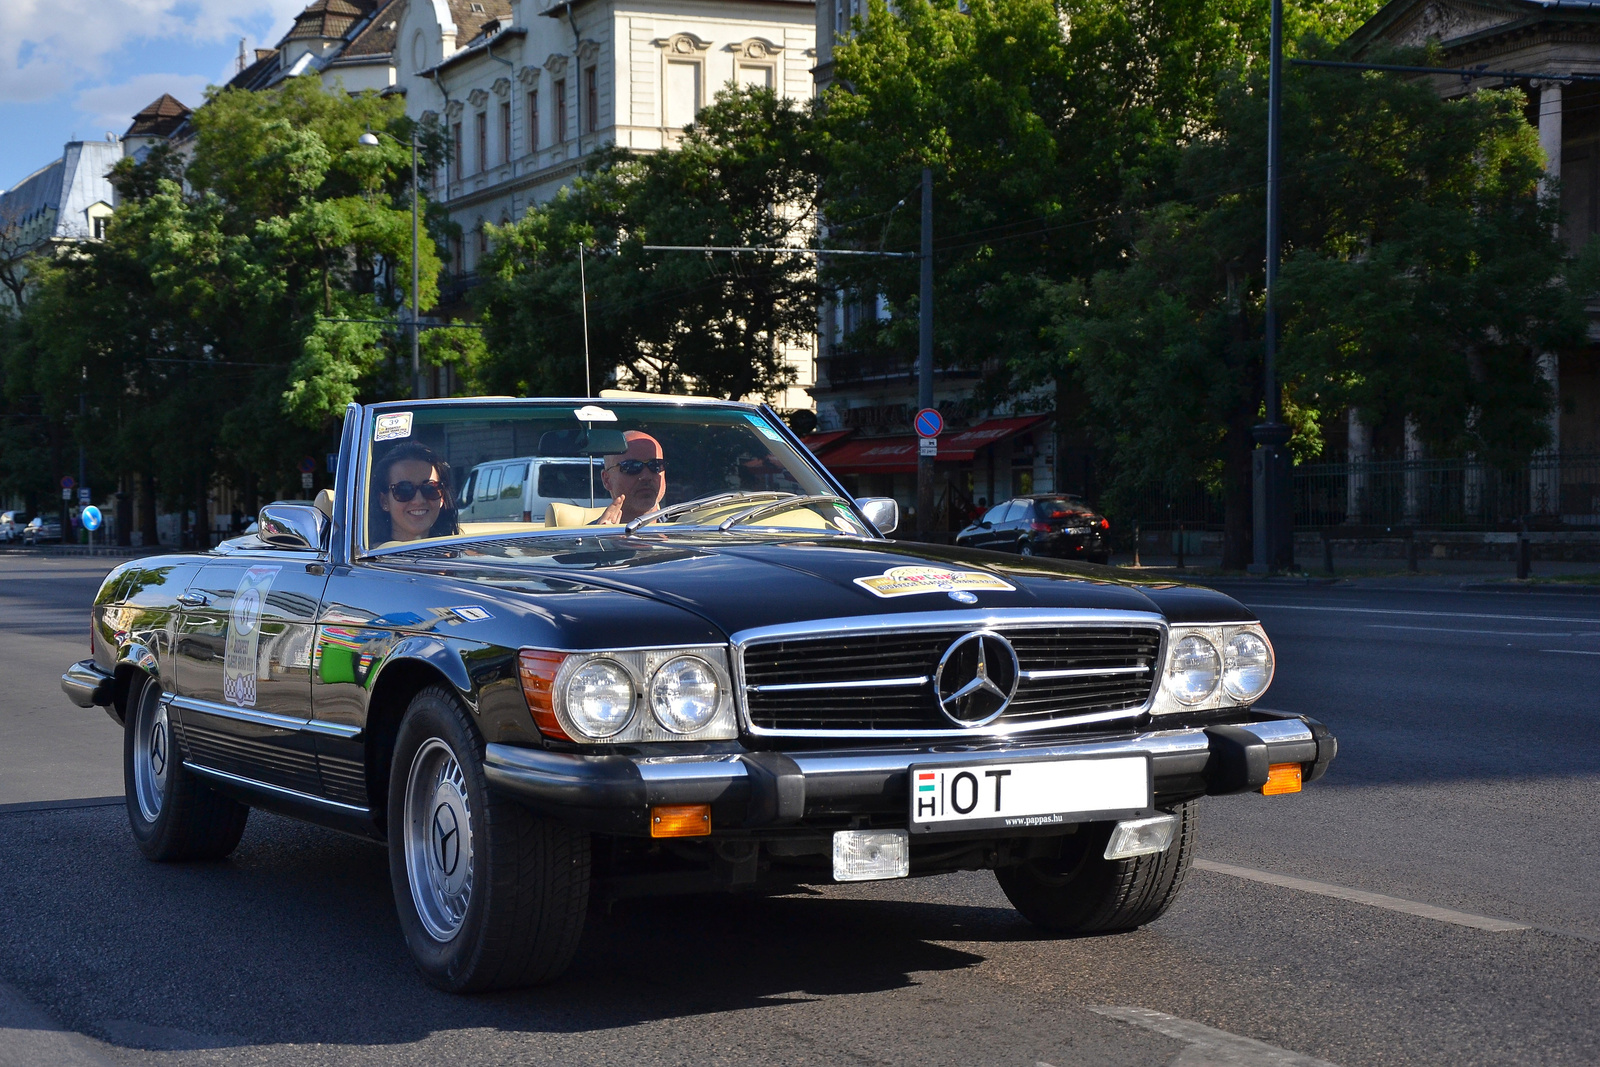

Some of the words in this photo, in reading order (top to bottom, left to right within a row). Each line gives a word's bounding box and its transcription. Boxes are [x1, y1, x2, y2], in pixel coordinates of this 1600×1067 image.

[240, 597, 253, 626] 39
[951, 769, 1012, 815] OT
[918, 796, 936, 817] H
[1005, 813, 1063, 826] www.pappas.hu
